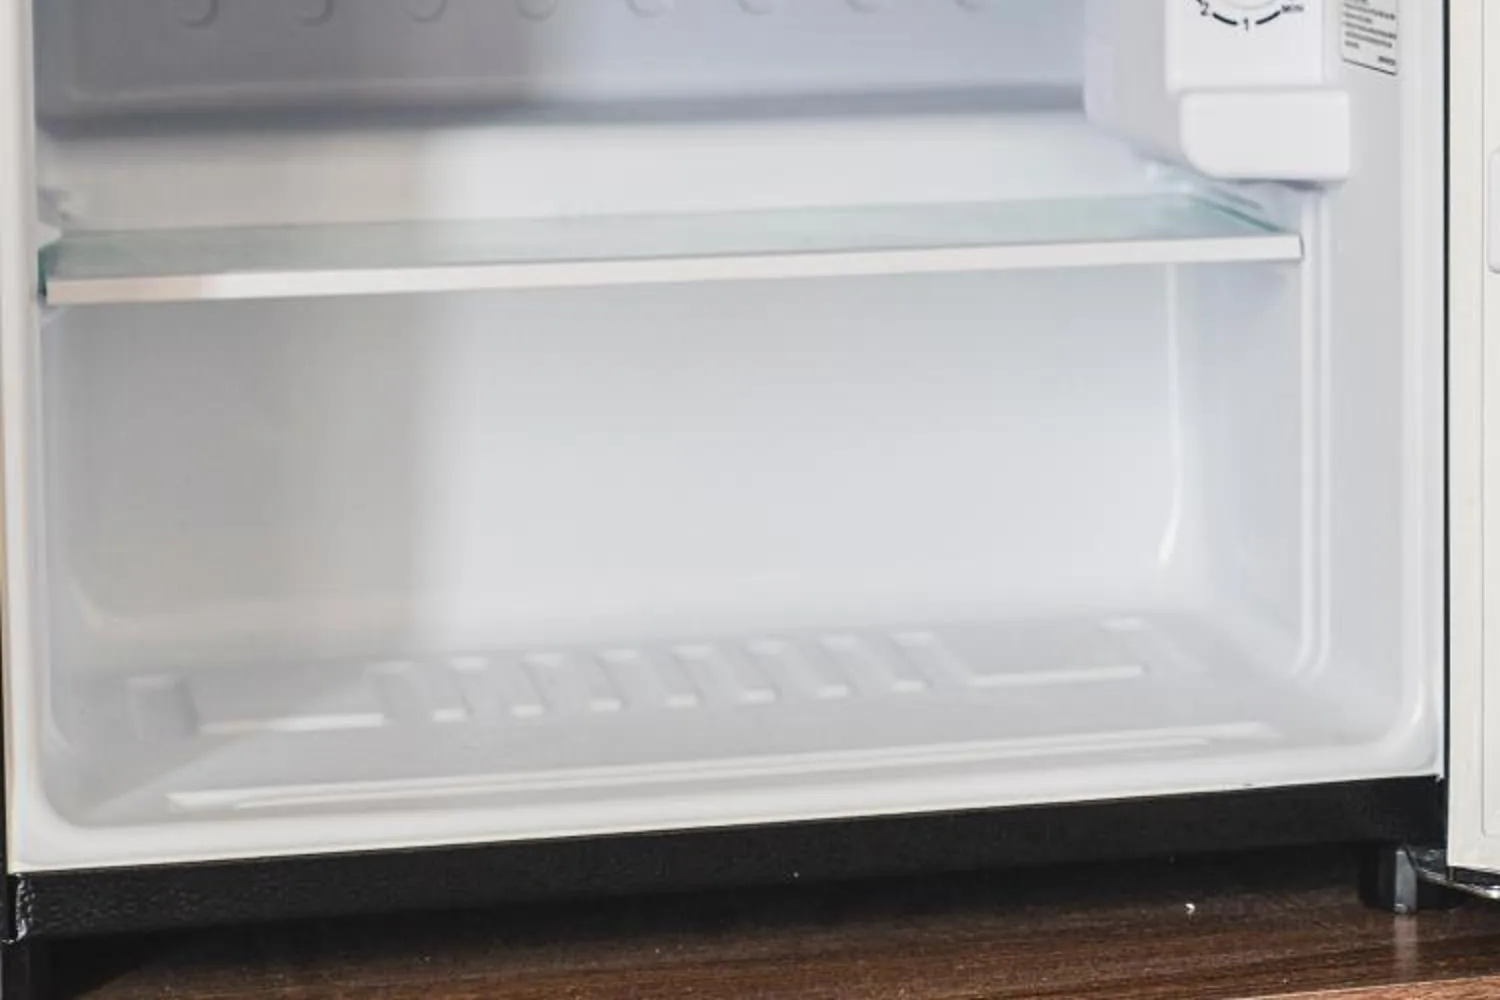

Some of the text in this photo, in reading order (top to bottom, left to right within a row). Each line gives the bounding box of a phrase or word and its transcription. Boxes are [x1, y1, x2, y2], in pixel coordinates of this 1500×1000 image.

[1200, 2, 1209, 17] 2
[1281, 4, 1305, 13] MIN
[1242, 18, 1250, 32] 1
